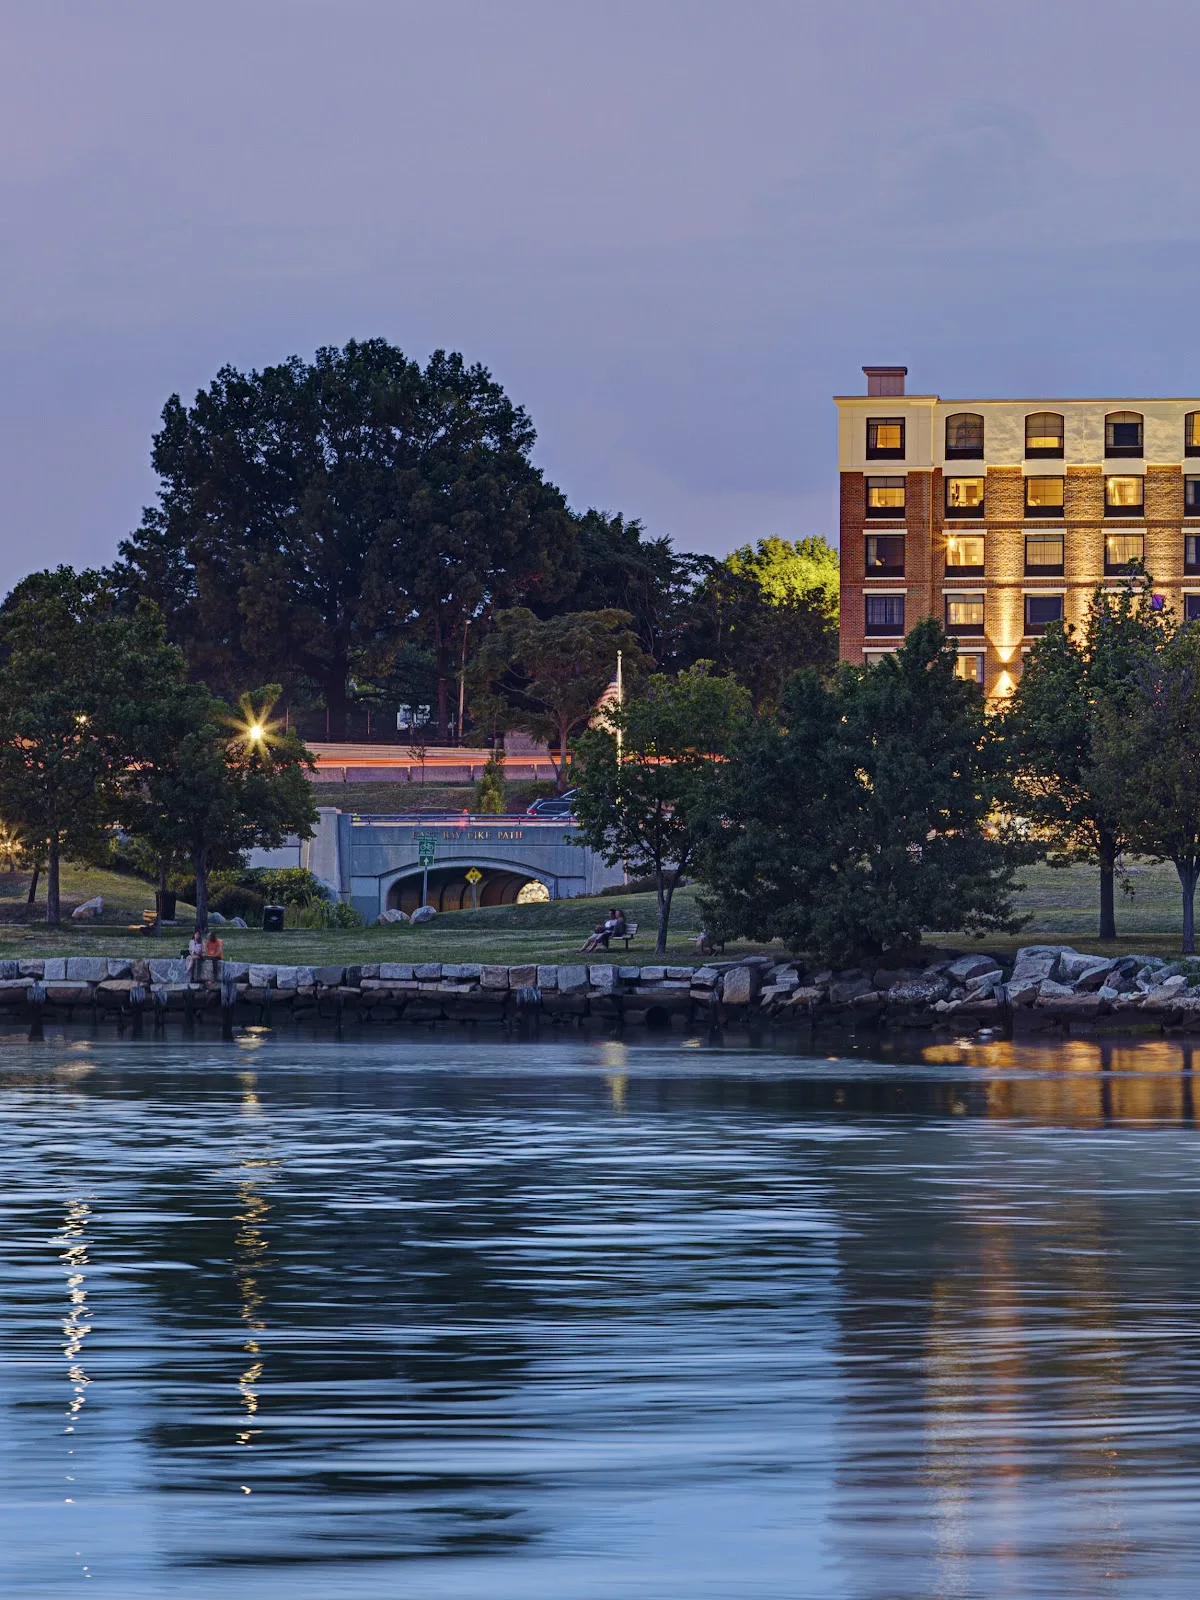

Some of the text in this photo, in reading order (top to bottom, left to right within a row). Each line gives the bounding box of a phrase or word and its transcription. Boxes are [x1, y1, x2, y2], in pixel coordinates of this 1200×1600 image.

[443, 831, 462, 839] BAY
[467, 831, 491, 840] BIKE
[497, 831, 523, 840] PATH
